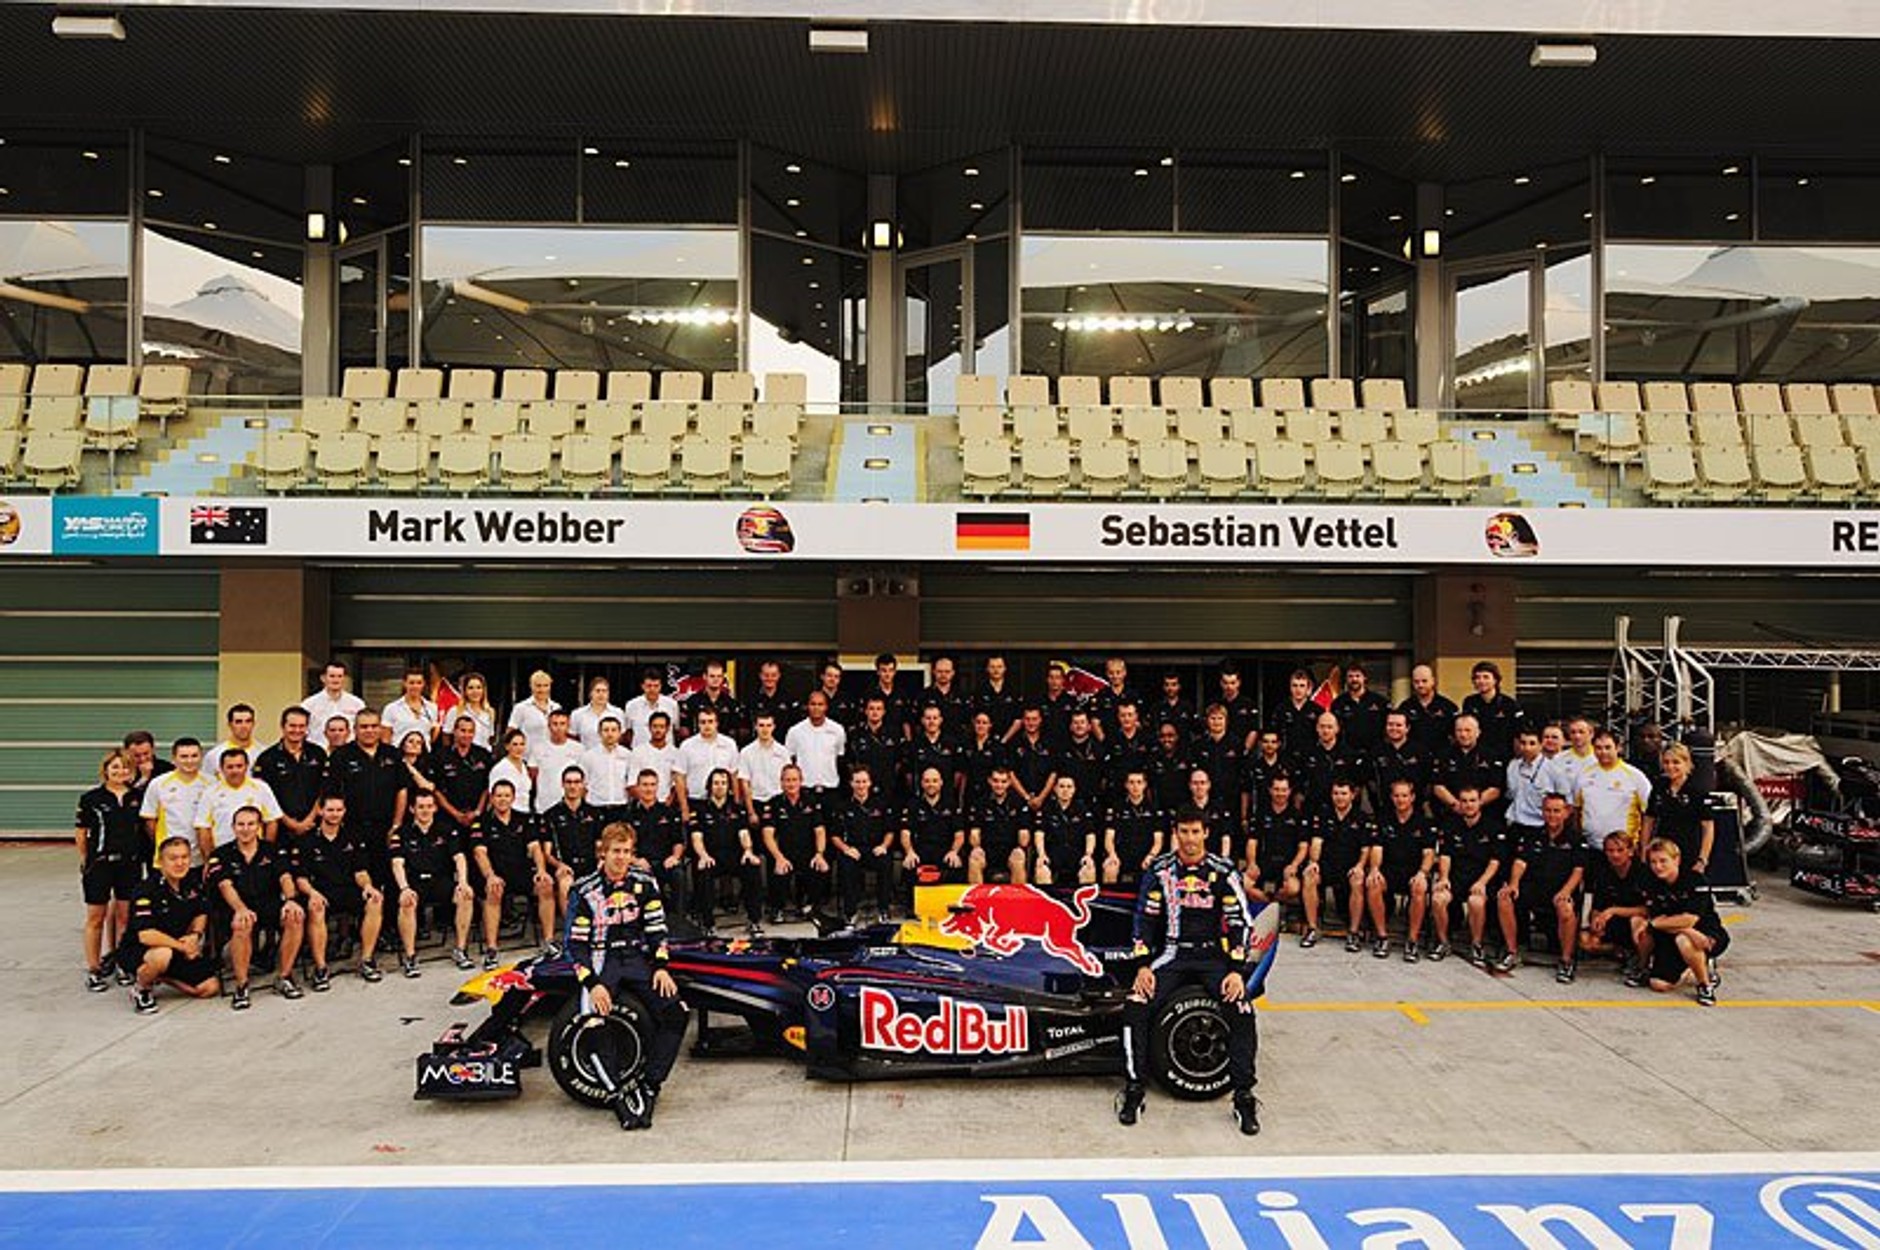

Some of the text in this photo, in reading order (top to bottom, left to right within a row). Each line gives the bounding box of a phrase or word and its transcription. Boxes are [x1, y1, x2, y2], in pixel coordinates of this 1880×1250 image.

[368, 510, 624, 543] Mark Webber
[1100, 514, 1398, 548] Sebastian Vettel
[1833, 521, 1879, 552] RE
[860, 986, 1028, 1054] Red Bull
[1047, 1026, 1085, 1039] TOTAL
[979, 1191, 1715, 1250] Allianz
